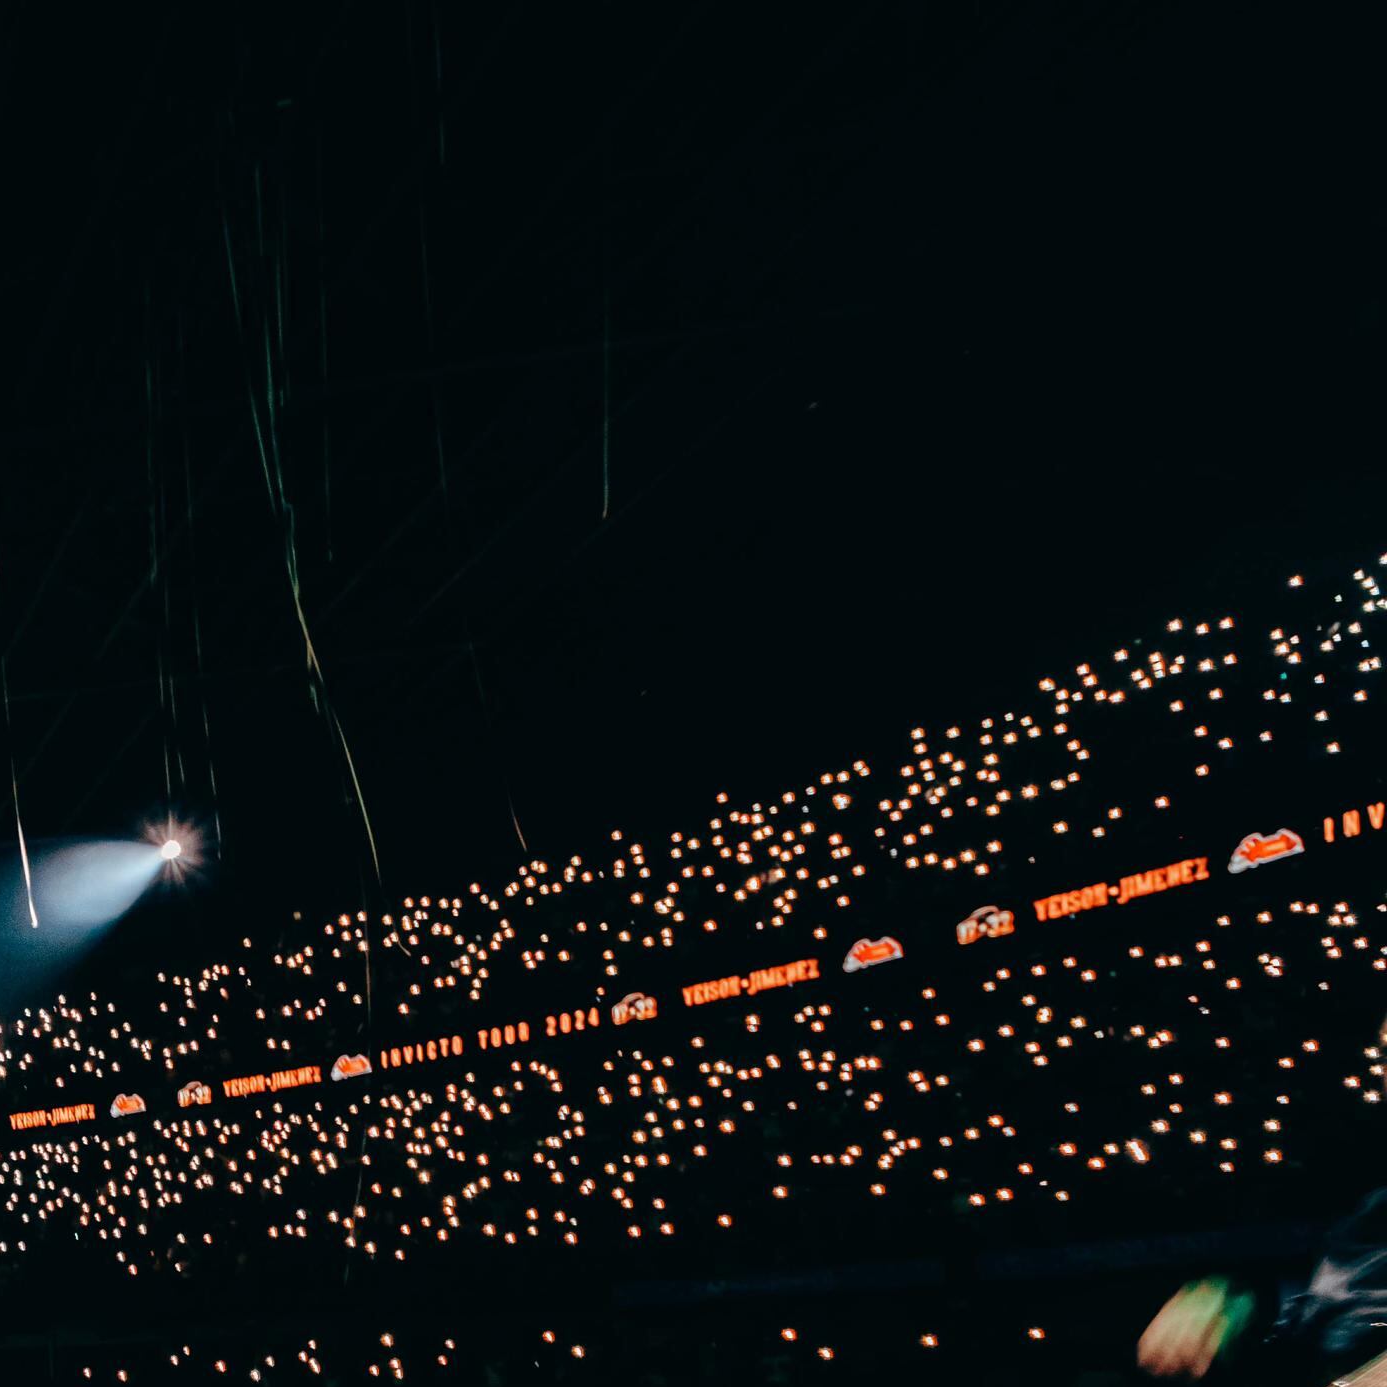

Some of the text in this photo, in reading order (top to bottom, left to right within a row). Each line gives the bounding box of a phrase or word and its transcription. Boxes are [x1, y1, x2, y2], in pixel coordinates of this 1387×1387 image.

[381, 1007, 600, 1069] INVICTO TOUR 2024
